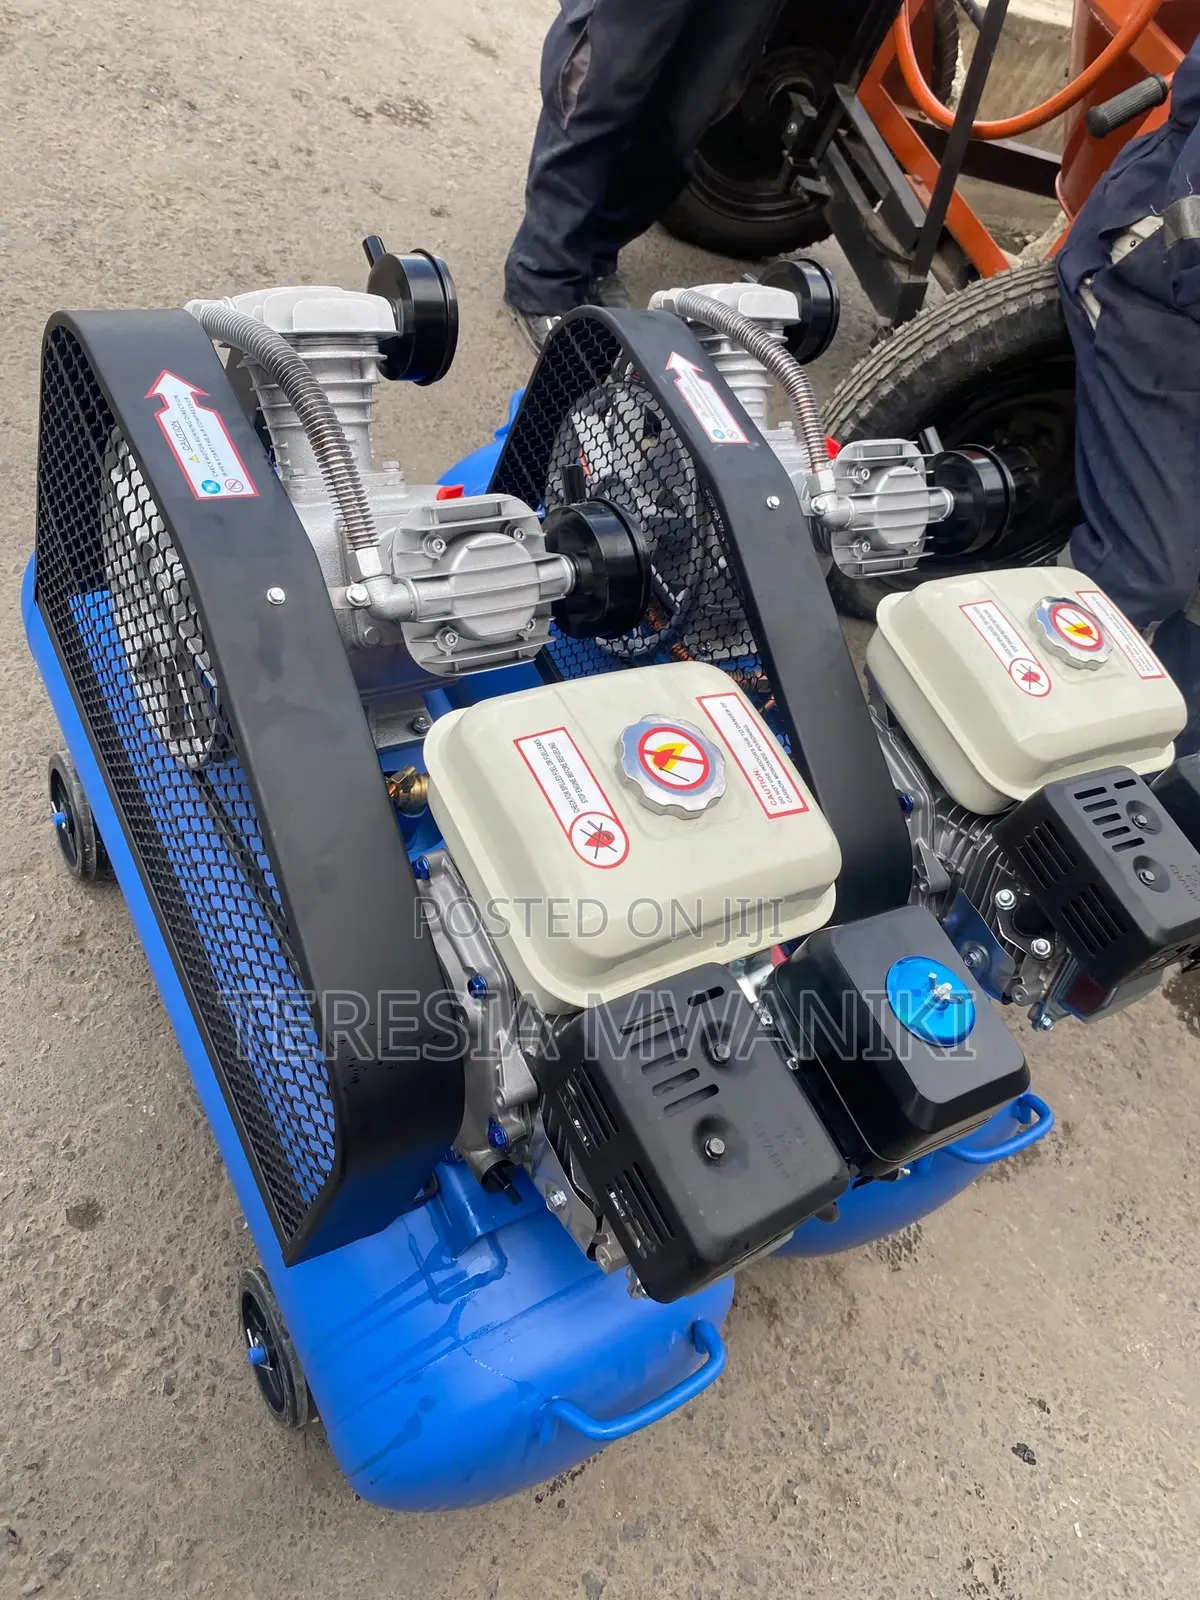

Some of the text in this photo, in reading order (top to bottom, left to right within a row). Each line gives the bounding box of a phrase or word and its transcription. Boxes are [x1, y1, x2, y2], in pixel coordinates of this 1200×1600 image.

[170, 420, 191, 452] CAUTION
[724, 708, 742, 730] DANGER
[738, 729, 746, 737] TO
[743, 737, 753, 748] DUE
[750, 747, 767, 772] INDOORS
[560, 762, 575, 779] BEFORE
[764, 772, 774, 784] USE
[554, 774, 569, 792] SPILLED
[569, 777, 583, 794] ENGINE
[753, 767, 778, 806] CAUTION:
[770, 784, 781, 796] NOT
[562, 790, 573, 800] FOR
[577, 793, 589, 804] STOP
[776, 779, 793, 804] CARBON
[567, 798, 581, 814] CHECK
[777, 795, 786, 805] DO
